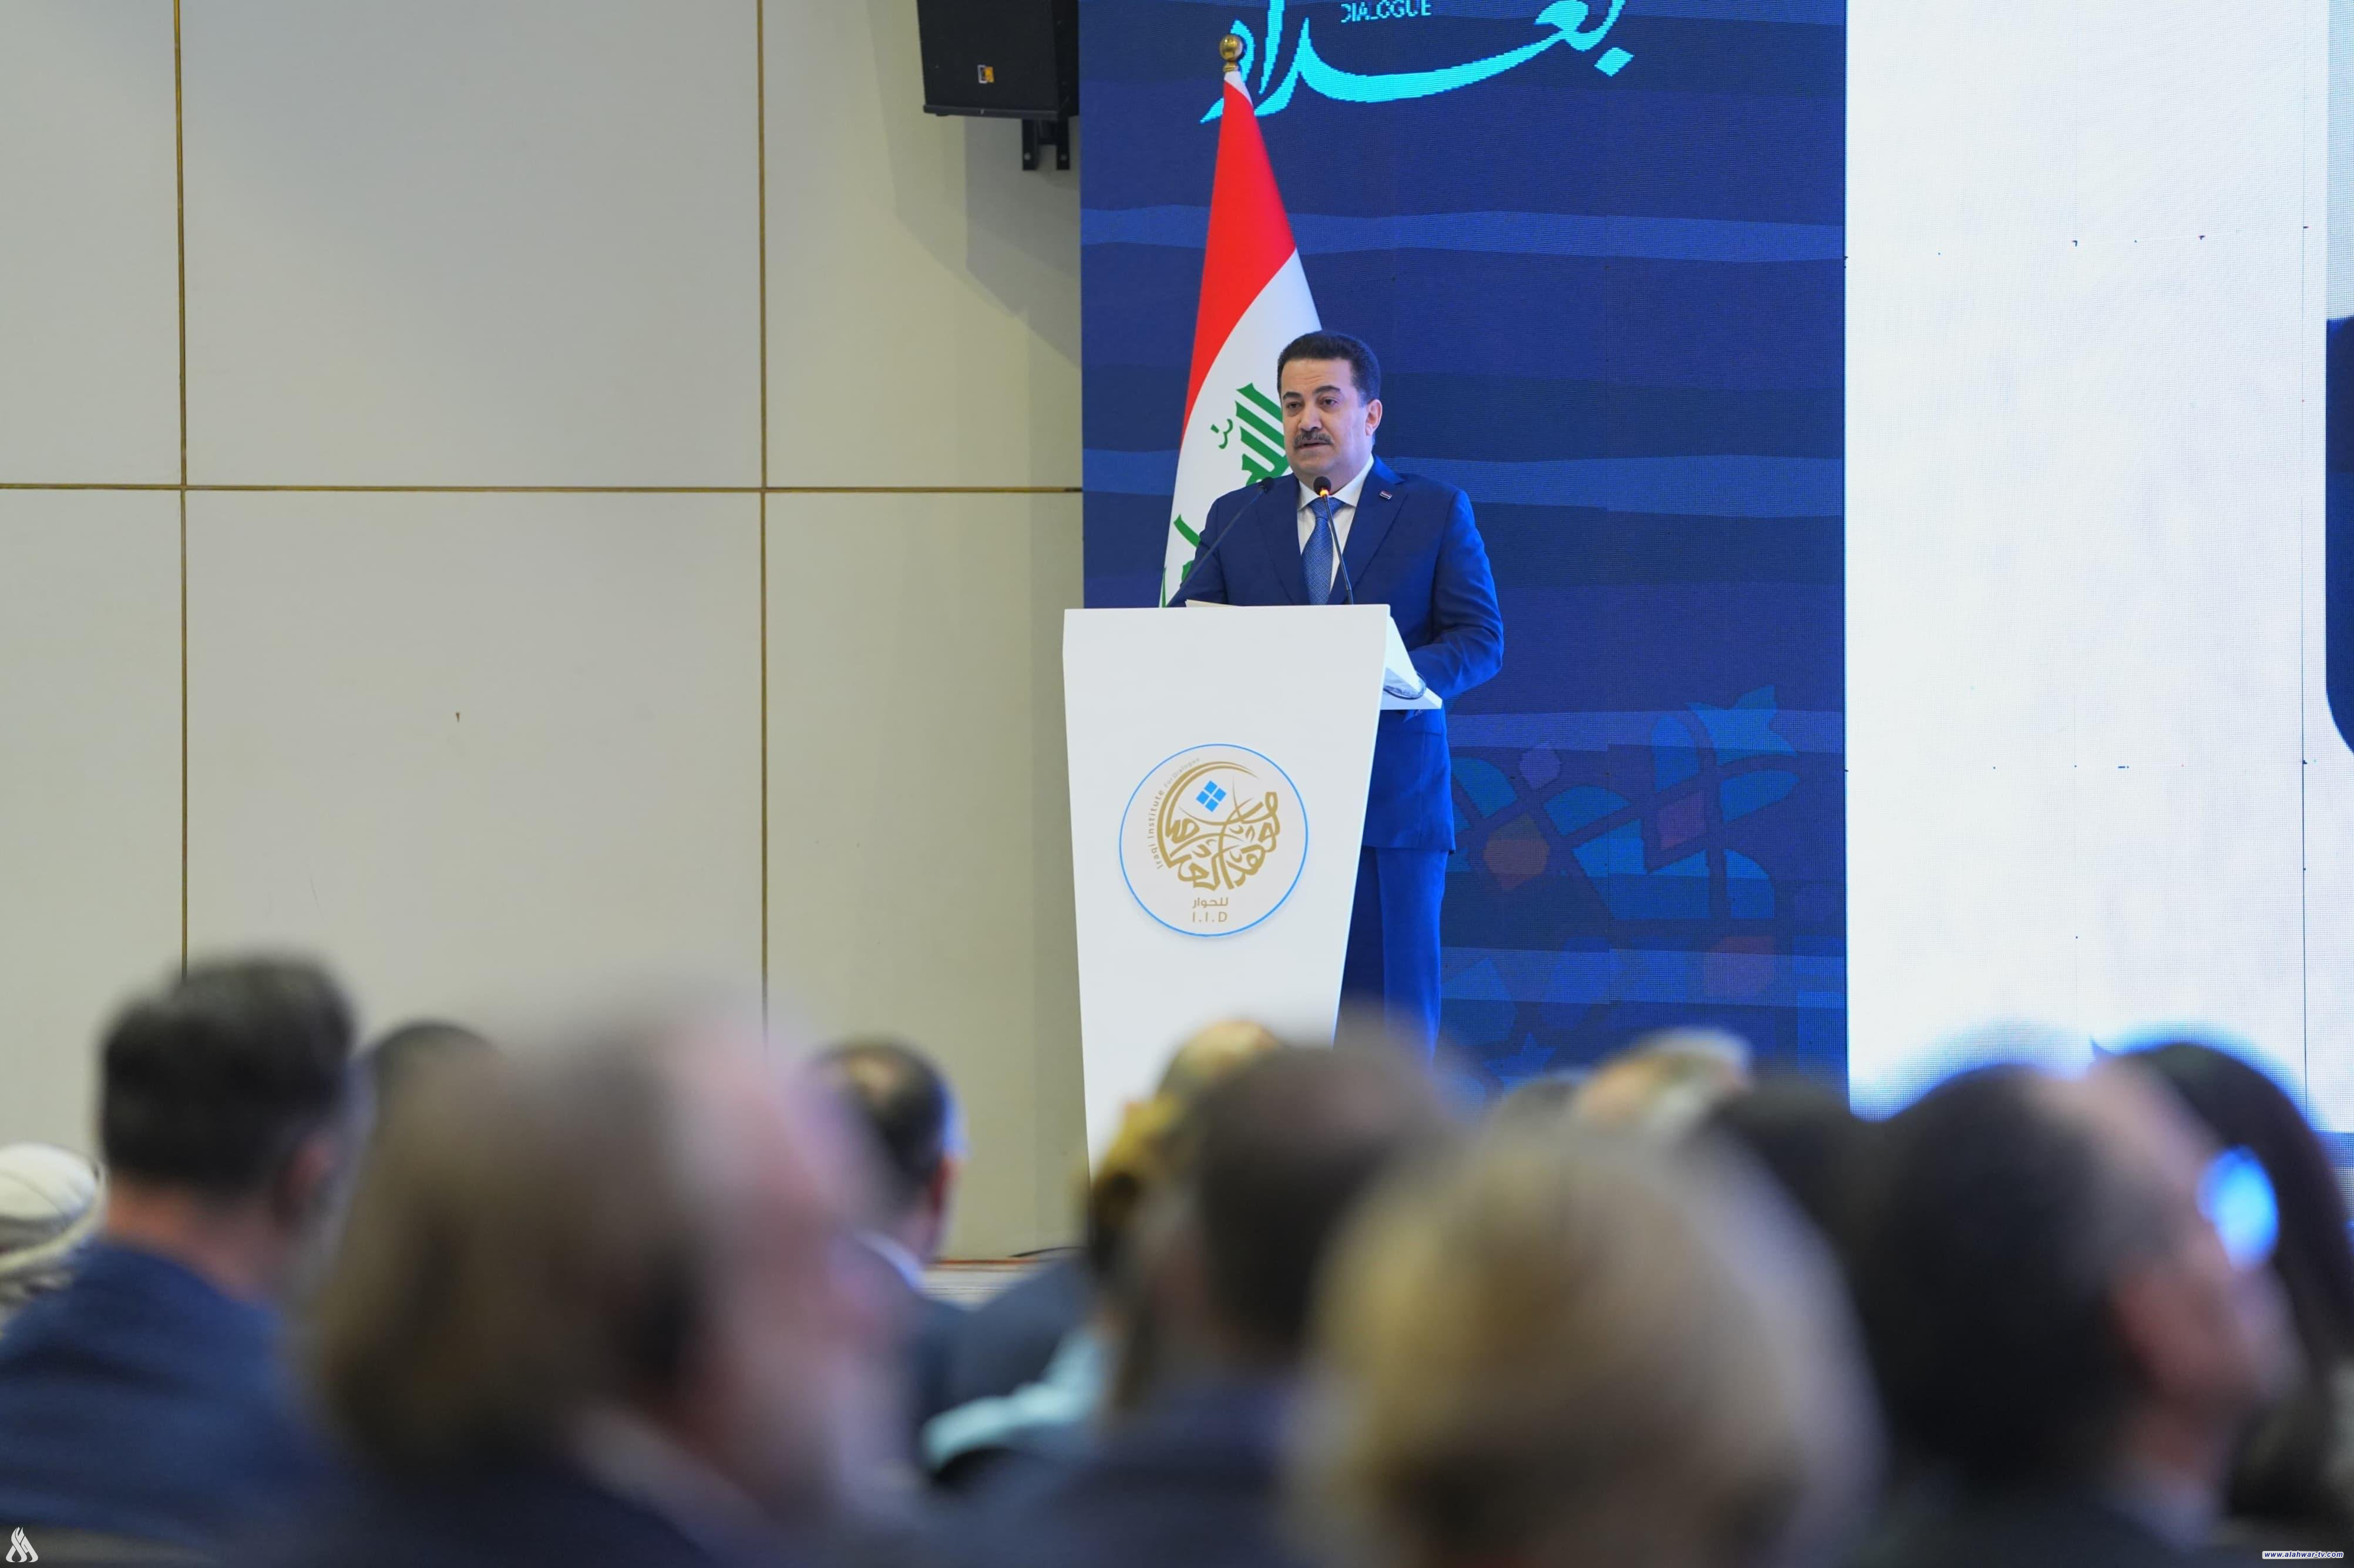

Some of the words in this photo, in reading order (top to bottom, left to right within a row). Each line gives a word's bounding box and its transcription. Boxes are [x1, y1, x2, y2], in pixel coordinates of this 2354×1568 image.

[1146, 789, 1164, 839] Institute
[1147, 844, 1163, 870] Iraqi
[1192, 897, 1229, 909] للحوار
